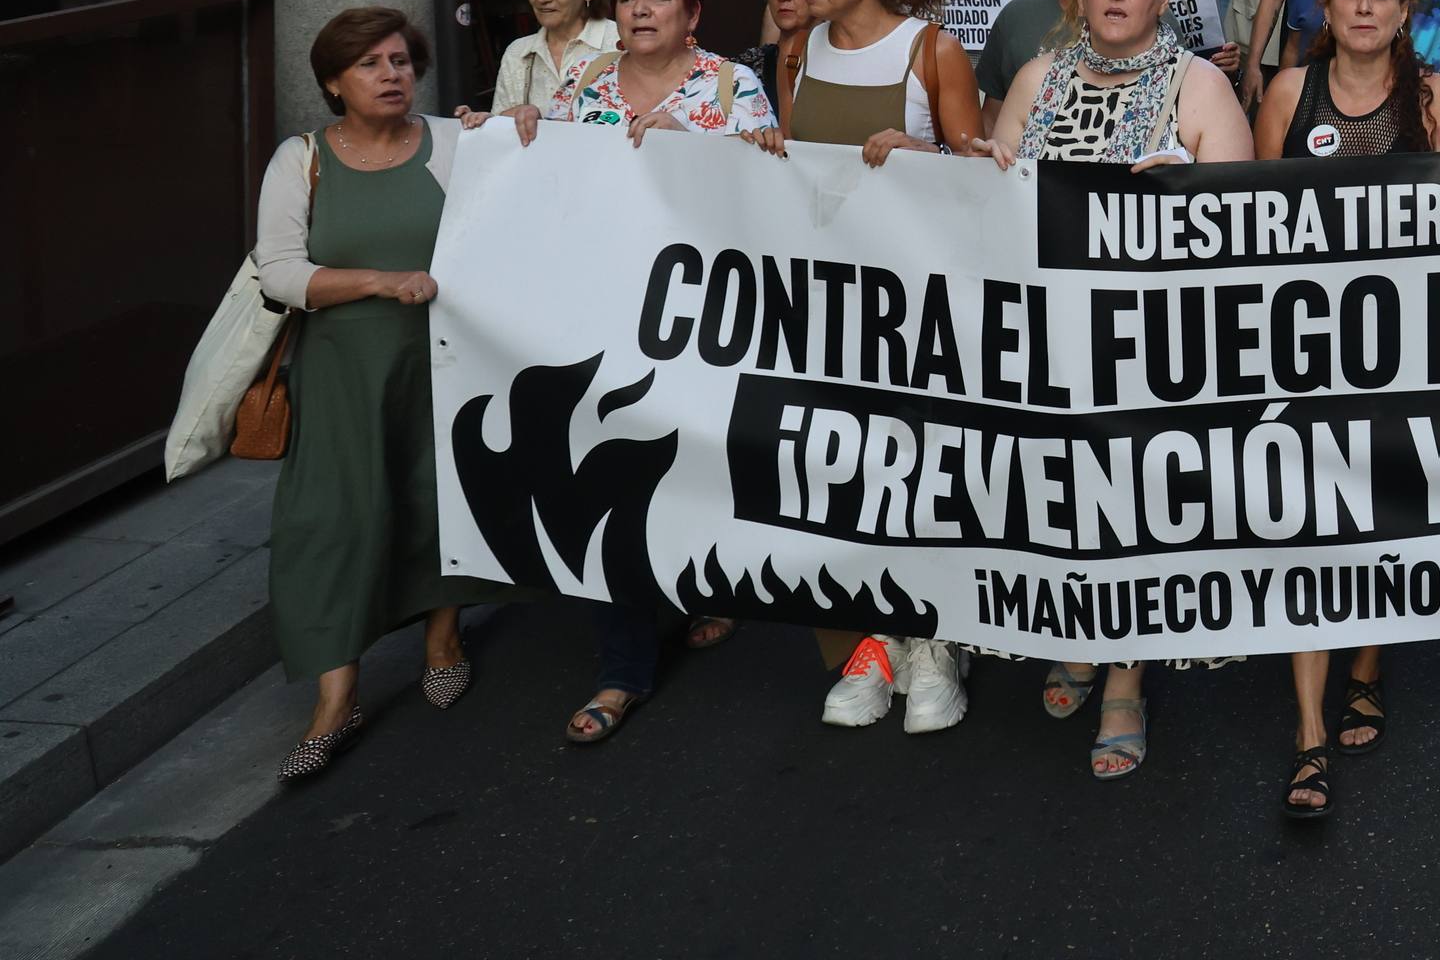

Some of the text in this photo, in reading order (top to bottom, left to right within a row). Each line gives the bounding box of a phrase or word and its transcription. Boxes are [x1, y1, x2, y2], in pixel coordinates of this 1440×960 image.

[943, 9, 989, 26] UIDADO
[1315, 136, 1333, 145] CNT
[1088, 188, 1330, 261] NUESTRA
[637, 242, 967, 396] CONTRA
[982, 277, 1071, 409] EL
[1090, 275, 1401, 407] FUEGO
[778, 402, 1375, 550] ¡PREVENCIÓN
[974, 567, 1232, 640] ¡MAÑUECO
[1240, 568, 1273, 628] Y
